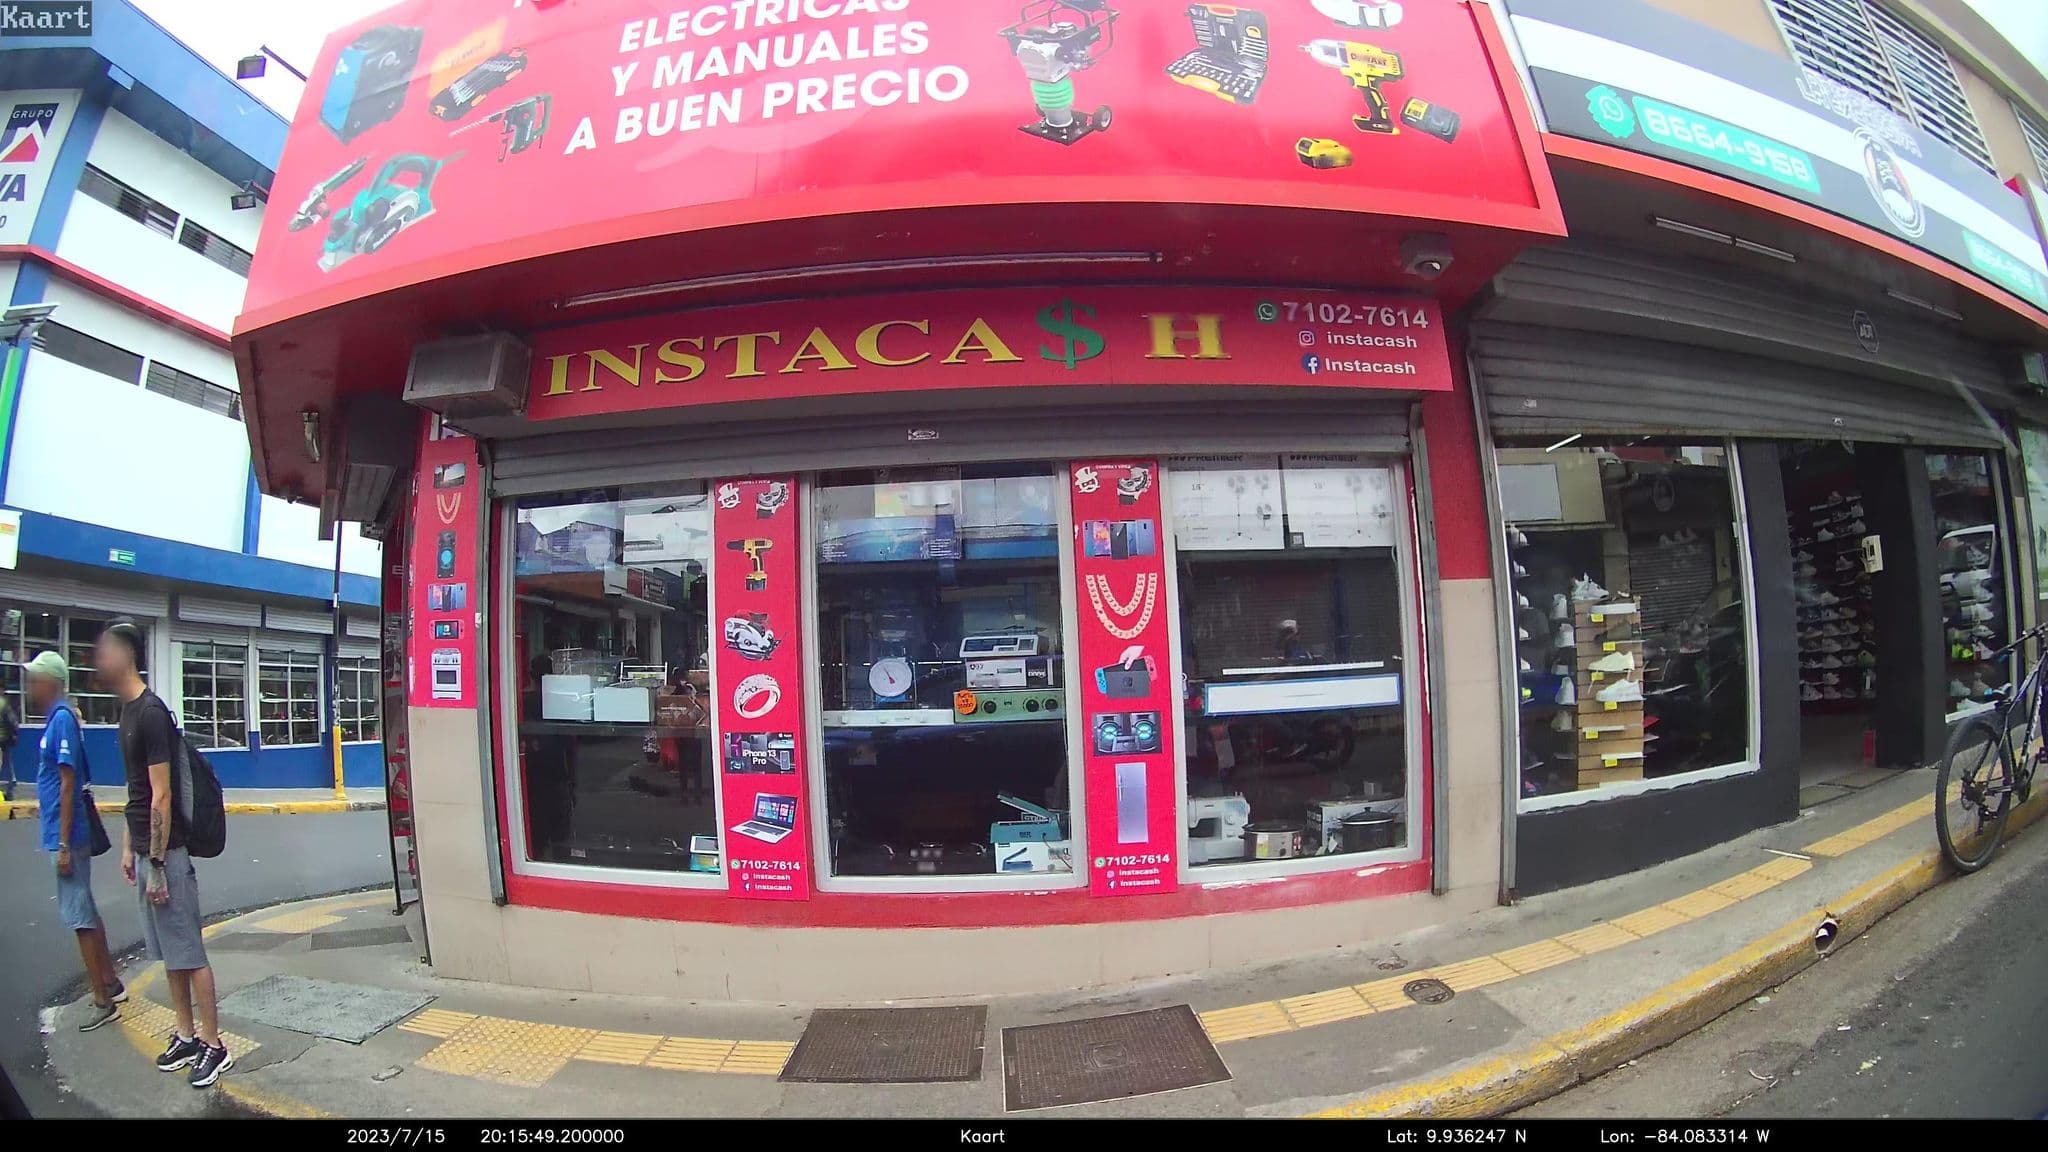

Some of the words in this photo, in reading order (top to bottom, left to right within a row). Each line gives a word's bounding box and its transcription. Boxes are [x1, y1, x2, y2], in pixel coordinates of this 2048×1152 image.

[611, 62, 640, 97] Y
[651, 21, 929, 89] MANUALES
[12, 109, 54, 120] GRUPO
[563, 117, 597, 155] A
[614, 87, 743, 144] BUEN
[762, 65, 970, 119] PRECIO
[1283, 302, 1429, 329] 7102-7614
[1327, 331, 1418, 348] instacash
[1325, 357, 1416, 375] Instacash
[742, 749, 767, 757] iPhone
[768, 749, 777, 757] 13
[752, 757, 767, 765] Pro
[740, 859, 801, 871] 7102-7614
[1105, 853, 1171, 866] 7102-7614
